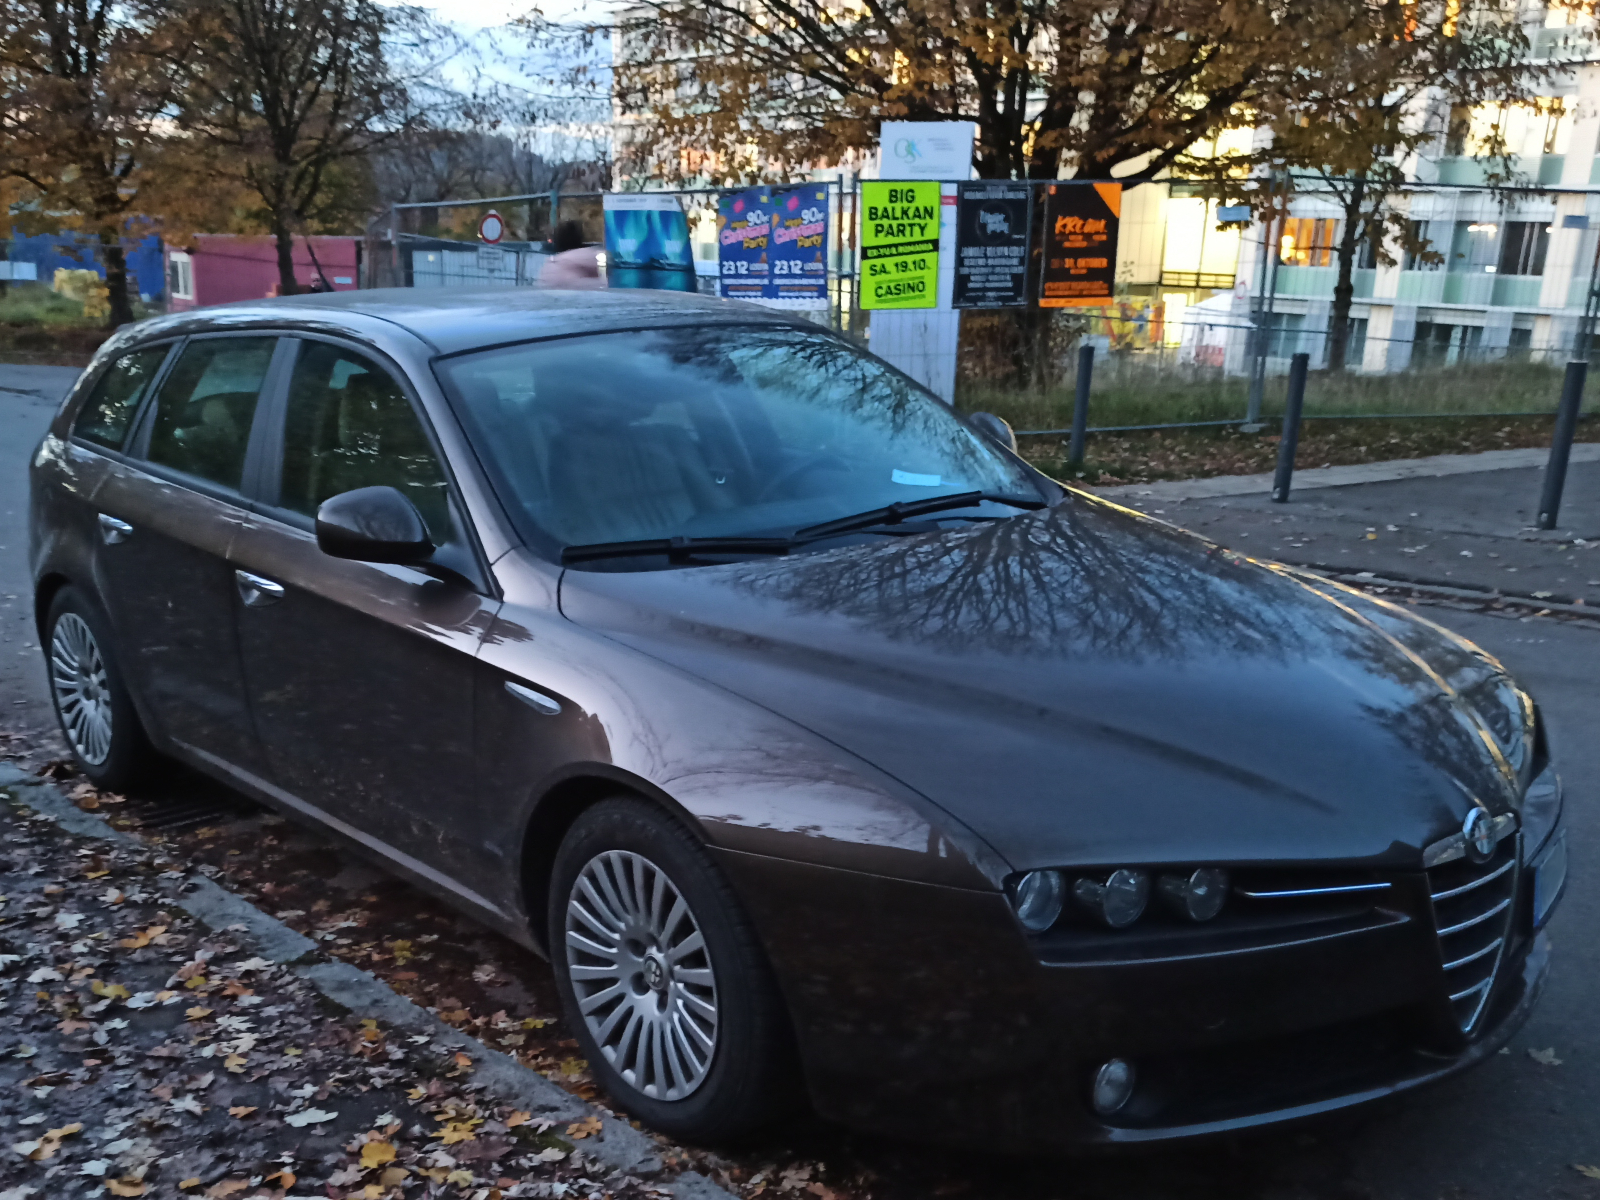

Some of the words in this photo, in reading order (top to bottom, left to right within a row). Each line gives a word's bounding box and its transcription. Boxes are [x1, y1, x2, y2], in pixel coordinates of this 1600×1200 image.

[889, 189, 915, 204] BIG
[868, 206, 934, 221] BALKAN
[874, 223, 928, 238] PARTY
[743, 237, 768, 250] Party
[797, 234, 823, 249] Party
[869, 263, 891, 276] SA.
[875, 281, 926, 298] CASINO
